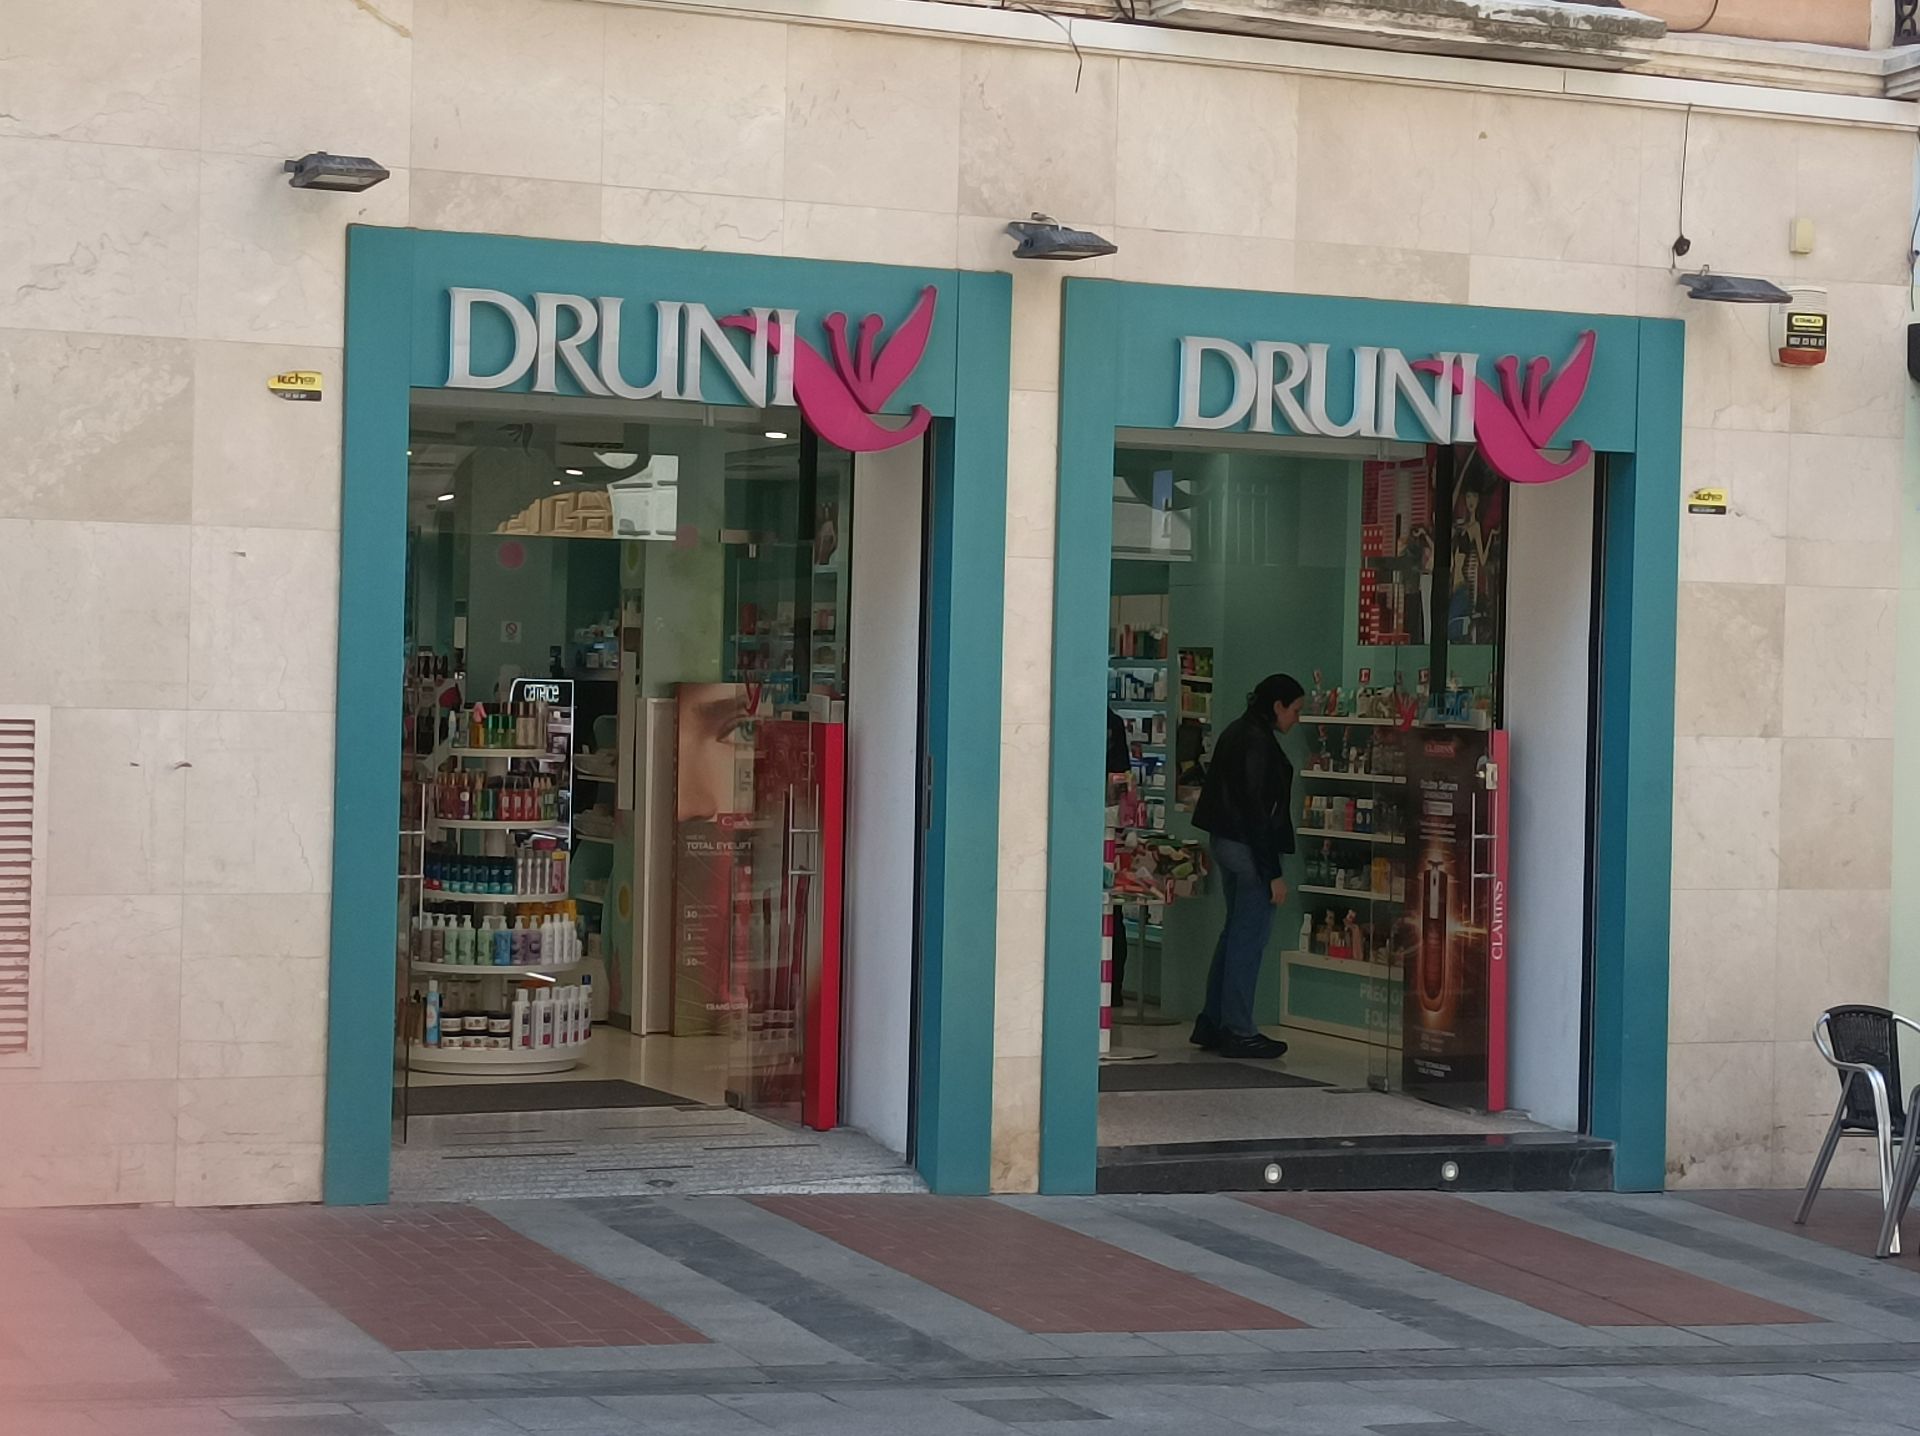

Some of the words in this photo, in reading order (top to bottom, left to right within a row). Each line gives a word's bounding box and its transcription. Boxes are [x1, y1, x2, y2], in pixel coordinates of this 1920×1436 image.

[444, 286, 800, 408] DRUNI
[1174, 336, 1480, 445] DRUNI
[687, 841, 714, 850] TOTAL
[1491, 881, 1503, 960] CLARINS
